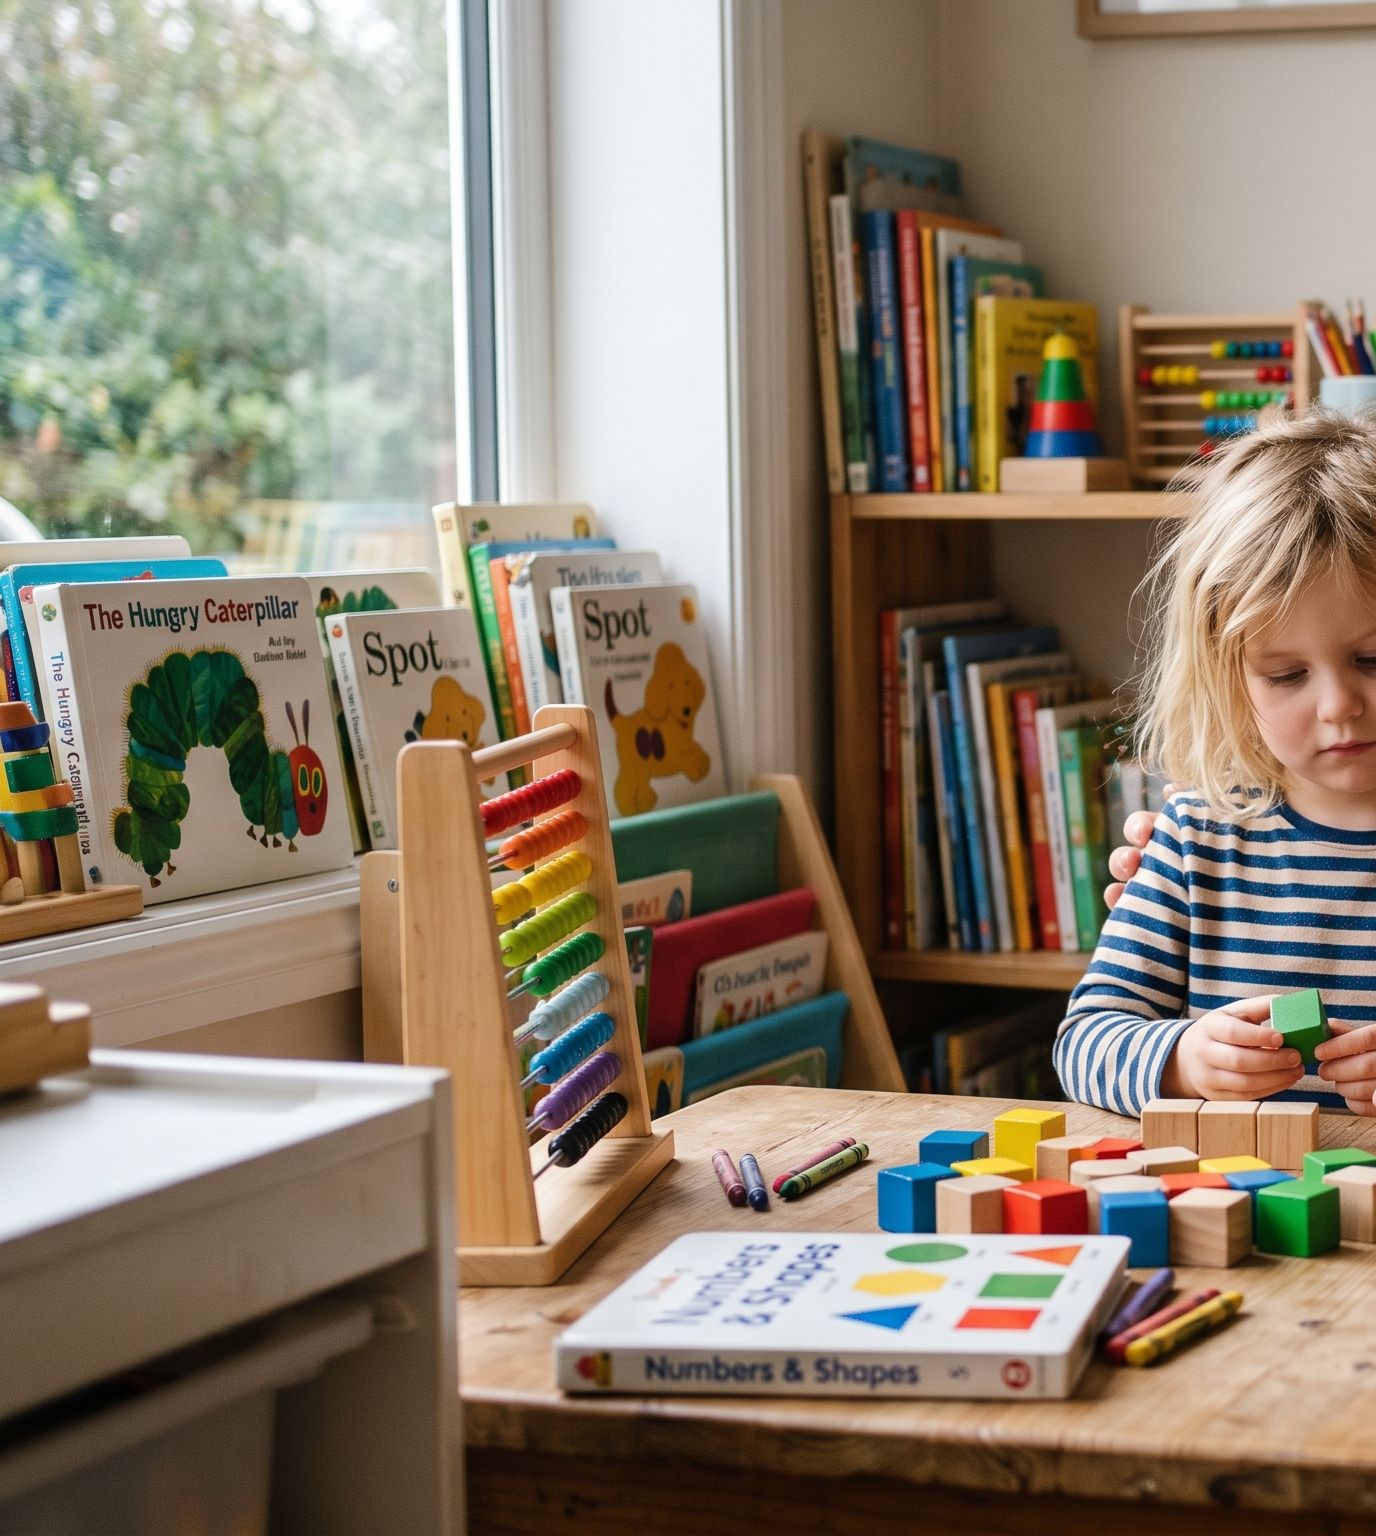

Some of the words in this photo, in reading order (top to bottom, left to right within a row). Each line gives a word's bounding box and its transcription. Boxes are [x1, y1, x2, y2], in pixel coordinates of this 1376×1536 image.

[83, 603, 124, 631] The
[128, 601, 199, 633] Hungry
[204, 595, 299, 627] Caterpillar
[583, 598, 651, 650] Spot
[50, 651, 65, 682] The
[363, 630, 443, 687] Spot
[650, 1243, 781, 1325] Numbers
[739, 1242, 842, 1306] Shapes
[644, 1355, 774, 1382] Numbers
[783, 1357, 804, 1382] &
[813, 1356, 920, 1390] Shapes
